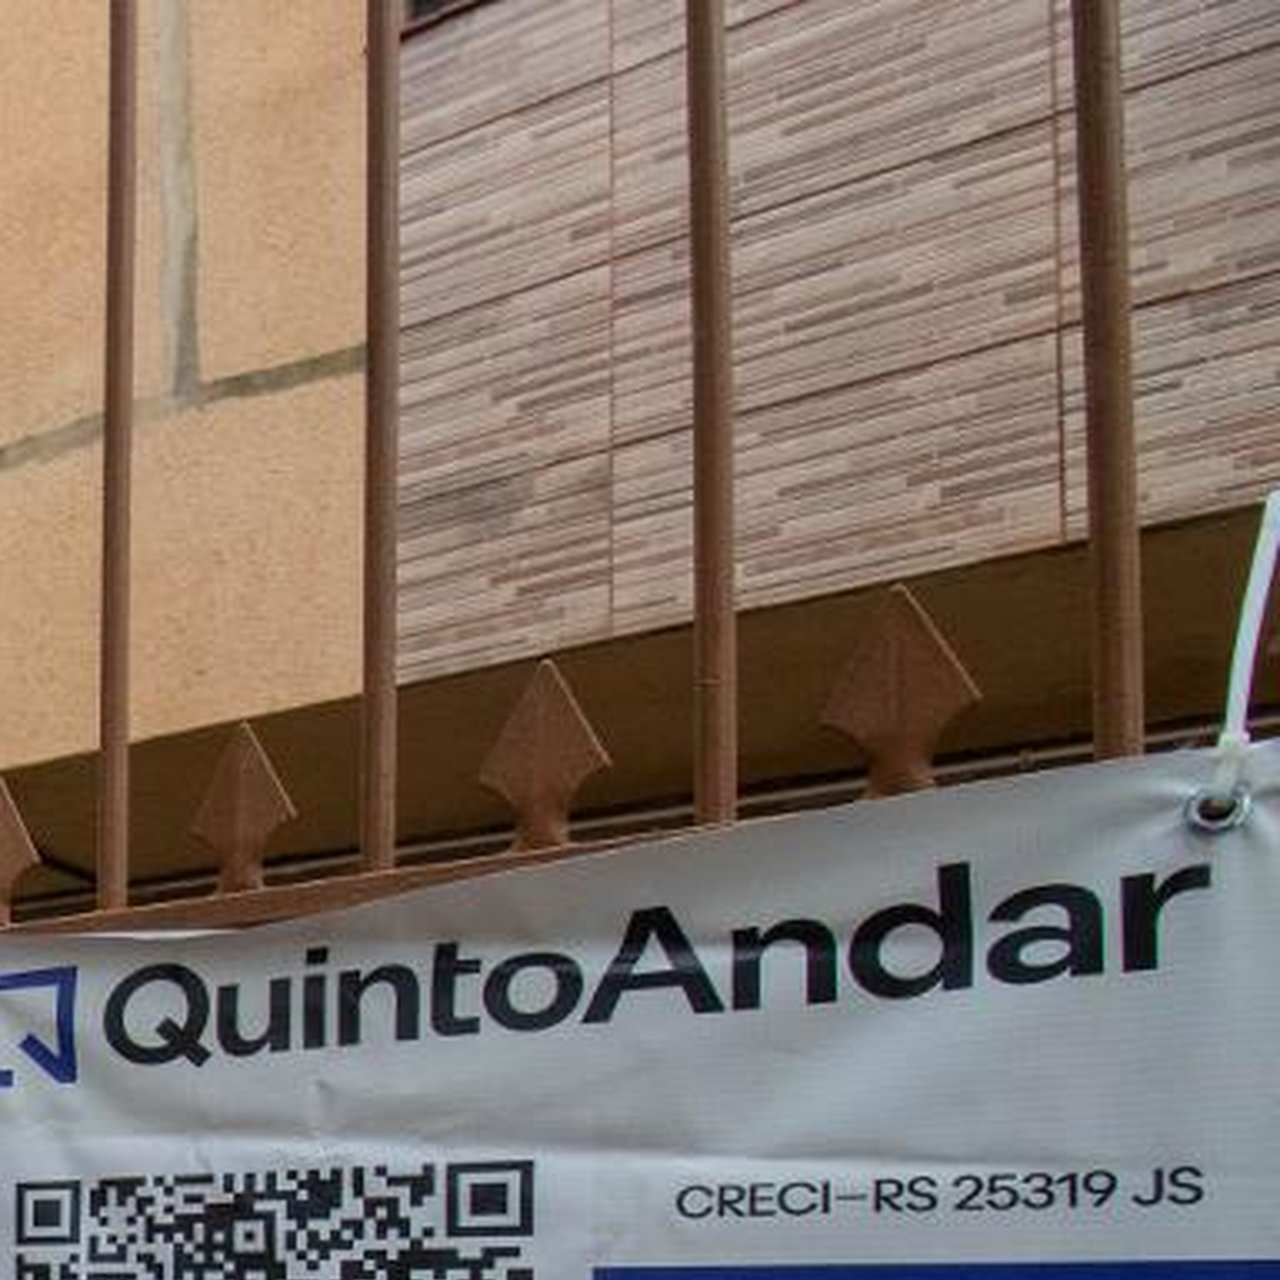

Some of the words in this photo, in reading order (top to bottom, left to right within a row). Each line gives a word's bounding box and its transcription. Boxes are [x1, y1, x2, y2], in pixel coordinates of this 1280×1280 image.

[102, 862, 1212, 1068] QuintoAndar
[674, 1175, 939, 1220] CRECI-RS
[951, 1168, 1119, 1213] 25319
[1130, 1165, 1206, 1208] JS
